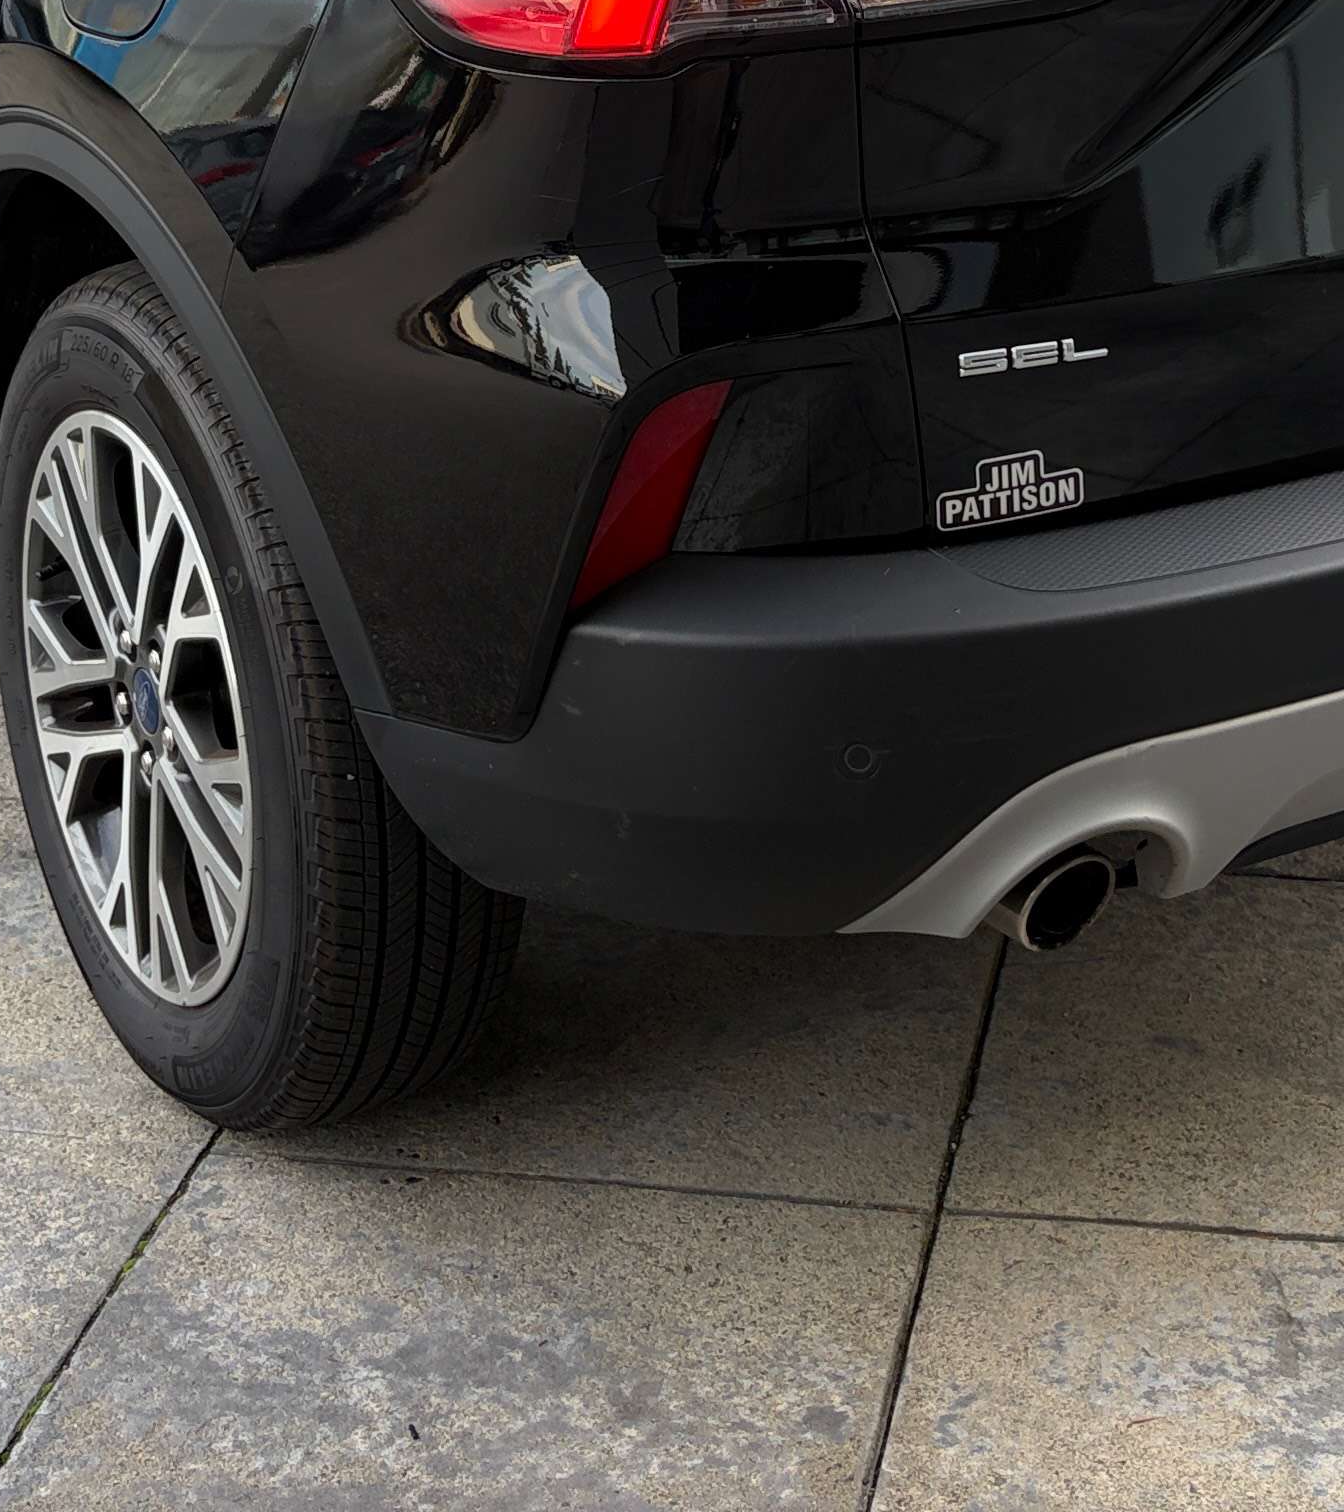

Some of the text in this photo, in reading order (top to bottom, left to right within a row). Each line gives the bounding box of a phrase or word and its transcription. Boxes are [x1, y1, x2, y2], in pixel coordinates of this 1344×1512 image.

[958, 337, 1109, 378] SEL
[984, 459, 1037, 493] JIM
[944, 477, 1076, 525] PATTISON
